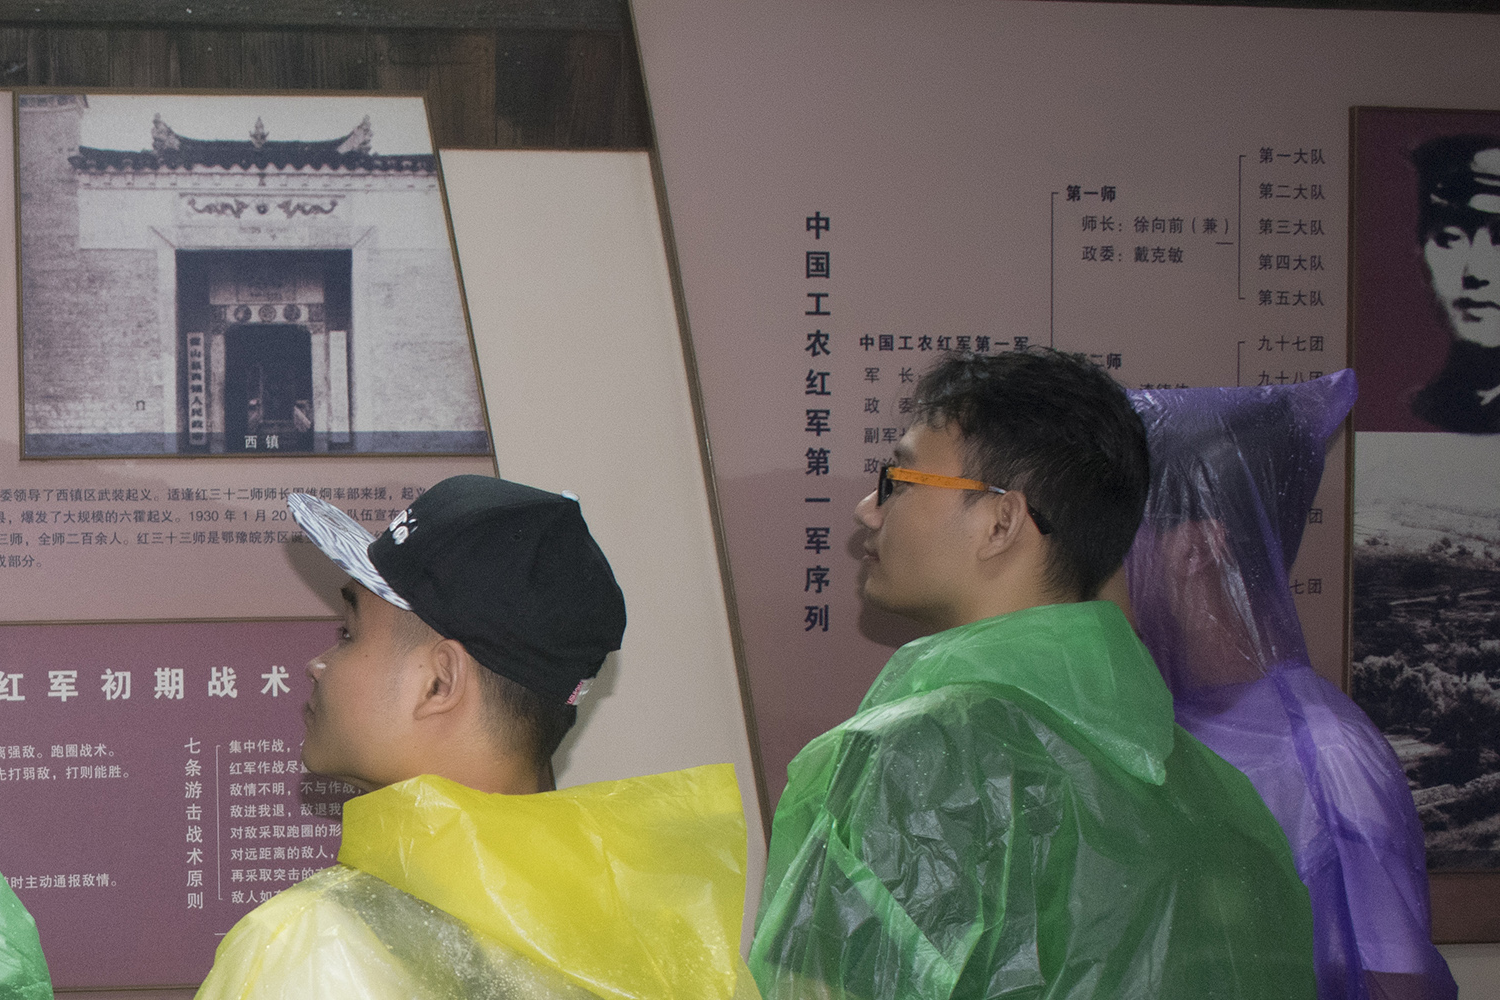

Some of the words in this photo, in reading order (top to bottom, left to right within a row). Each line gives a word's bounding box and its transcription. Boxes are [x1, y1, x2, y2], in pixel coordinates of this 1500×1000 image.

[1257, 147, 1327, 165] 第一大队
[1065, 184, 1118, 203] 第一师
[1257, 182, 1327, 201] 第二大队
[1257, 218, 1326, 237] 第三大队
[1257, 253, 1326, 272] 第四大队
[1257, 288, 1326, 307] 第五大队
[859, 334, 1030, 353] 中国工农红军第一军
[1257, 335, 1325, 352] 九十七团
[803, 211, 832, 633] 中国工农红军第一军序列
[244, 435, 280, 450] 西镇
[864, 427, 906, 444] 副军
[184, 737, 204, 910] 七条游击战术原则
[4, 872, 118, 890] 时主动通报敌情。
